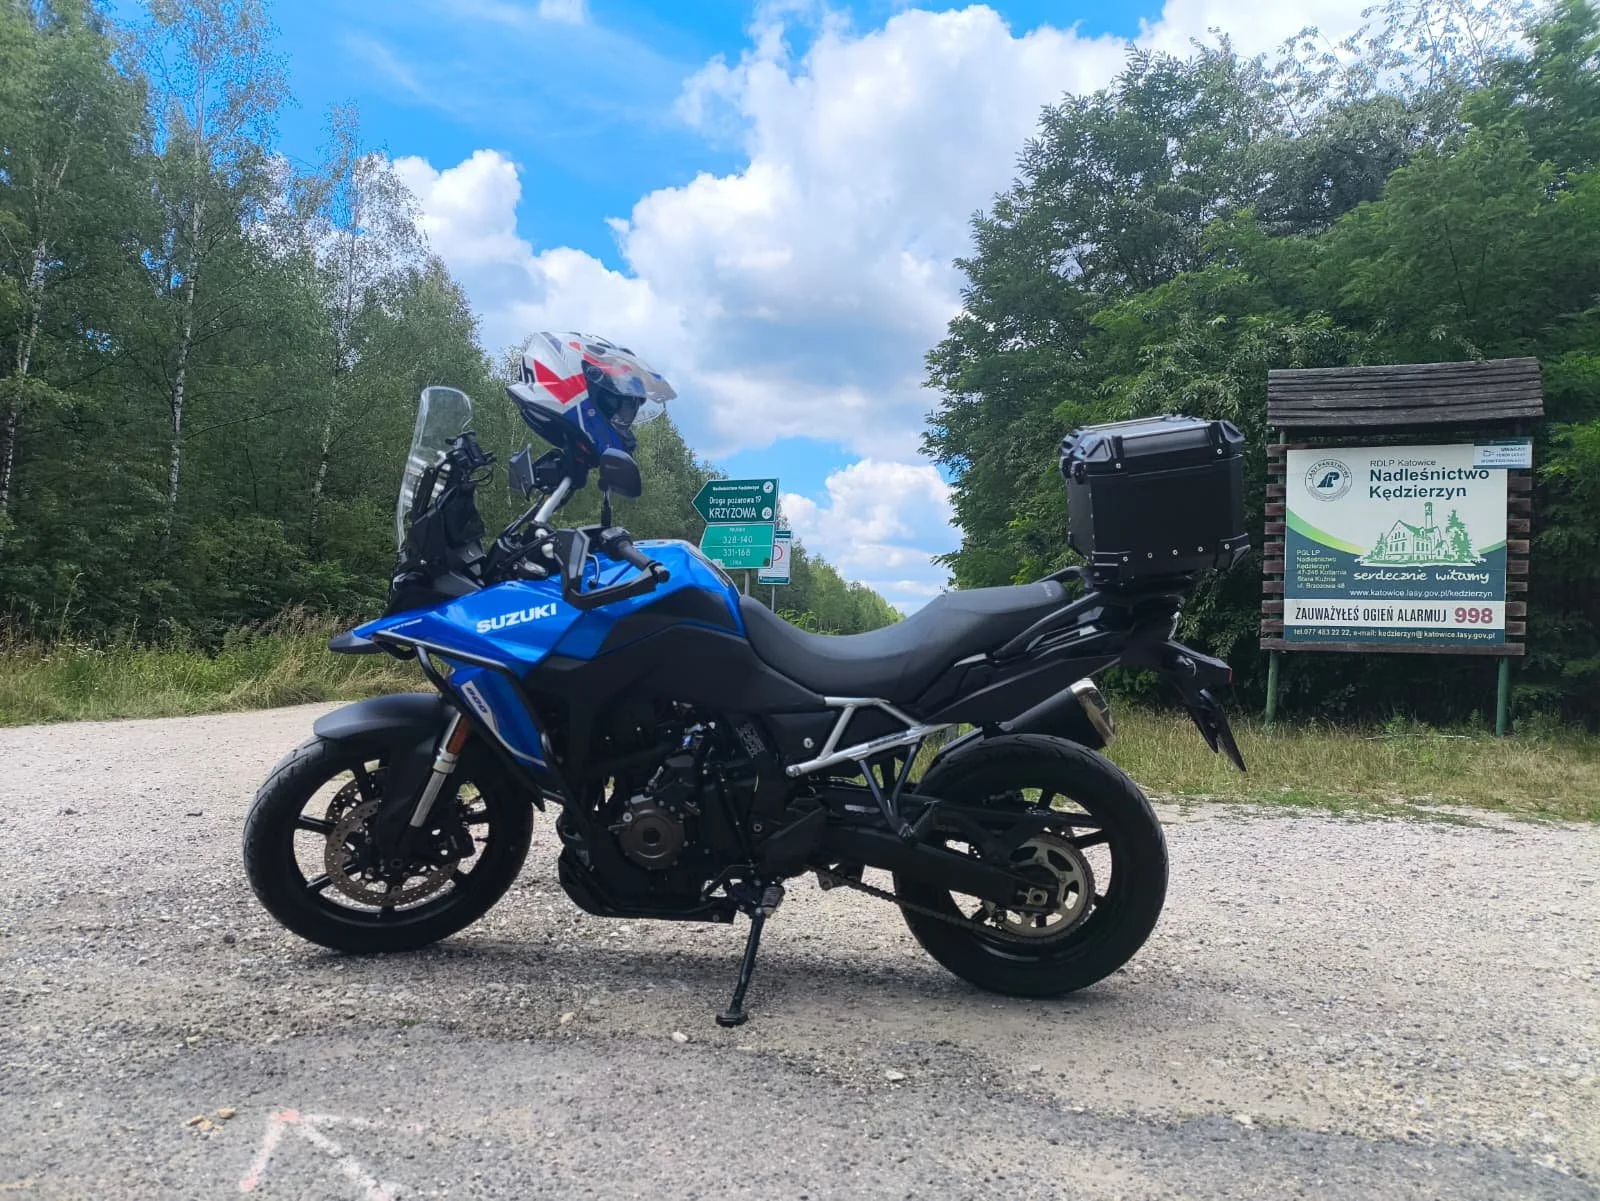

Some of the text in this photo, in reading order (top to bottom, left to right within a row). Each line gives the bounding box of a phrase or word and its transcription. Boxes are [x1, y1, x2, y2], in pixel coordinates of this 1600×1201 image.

[1370, 458, 1437, 467] RDLP Katowice
[1369, 466, 1490, 482] Nadleśnictwo
[709, 496, 726, 506] Droga
[755, 495, 762, 504] 19
[1369, 484, 1467, 501] Kędzierzyn
[1353, 568, 1490, 584] serdecznie witamy
[1349, 588, 1493, 598] www.katowice.lasy.gov.pl/kedzierzyn
[476, 602, 557, 634] SUZUKI
[1295, 605, 1494, 624] ZAUWAŻYŁEŚ OGIEŃ ALARMUJ 998
